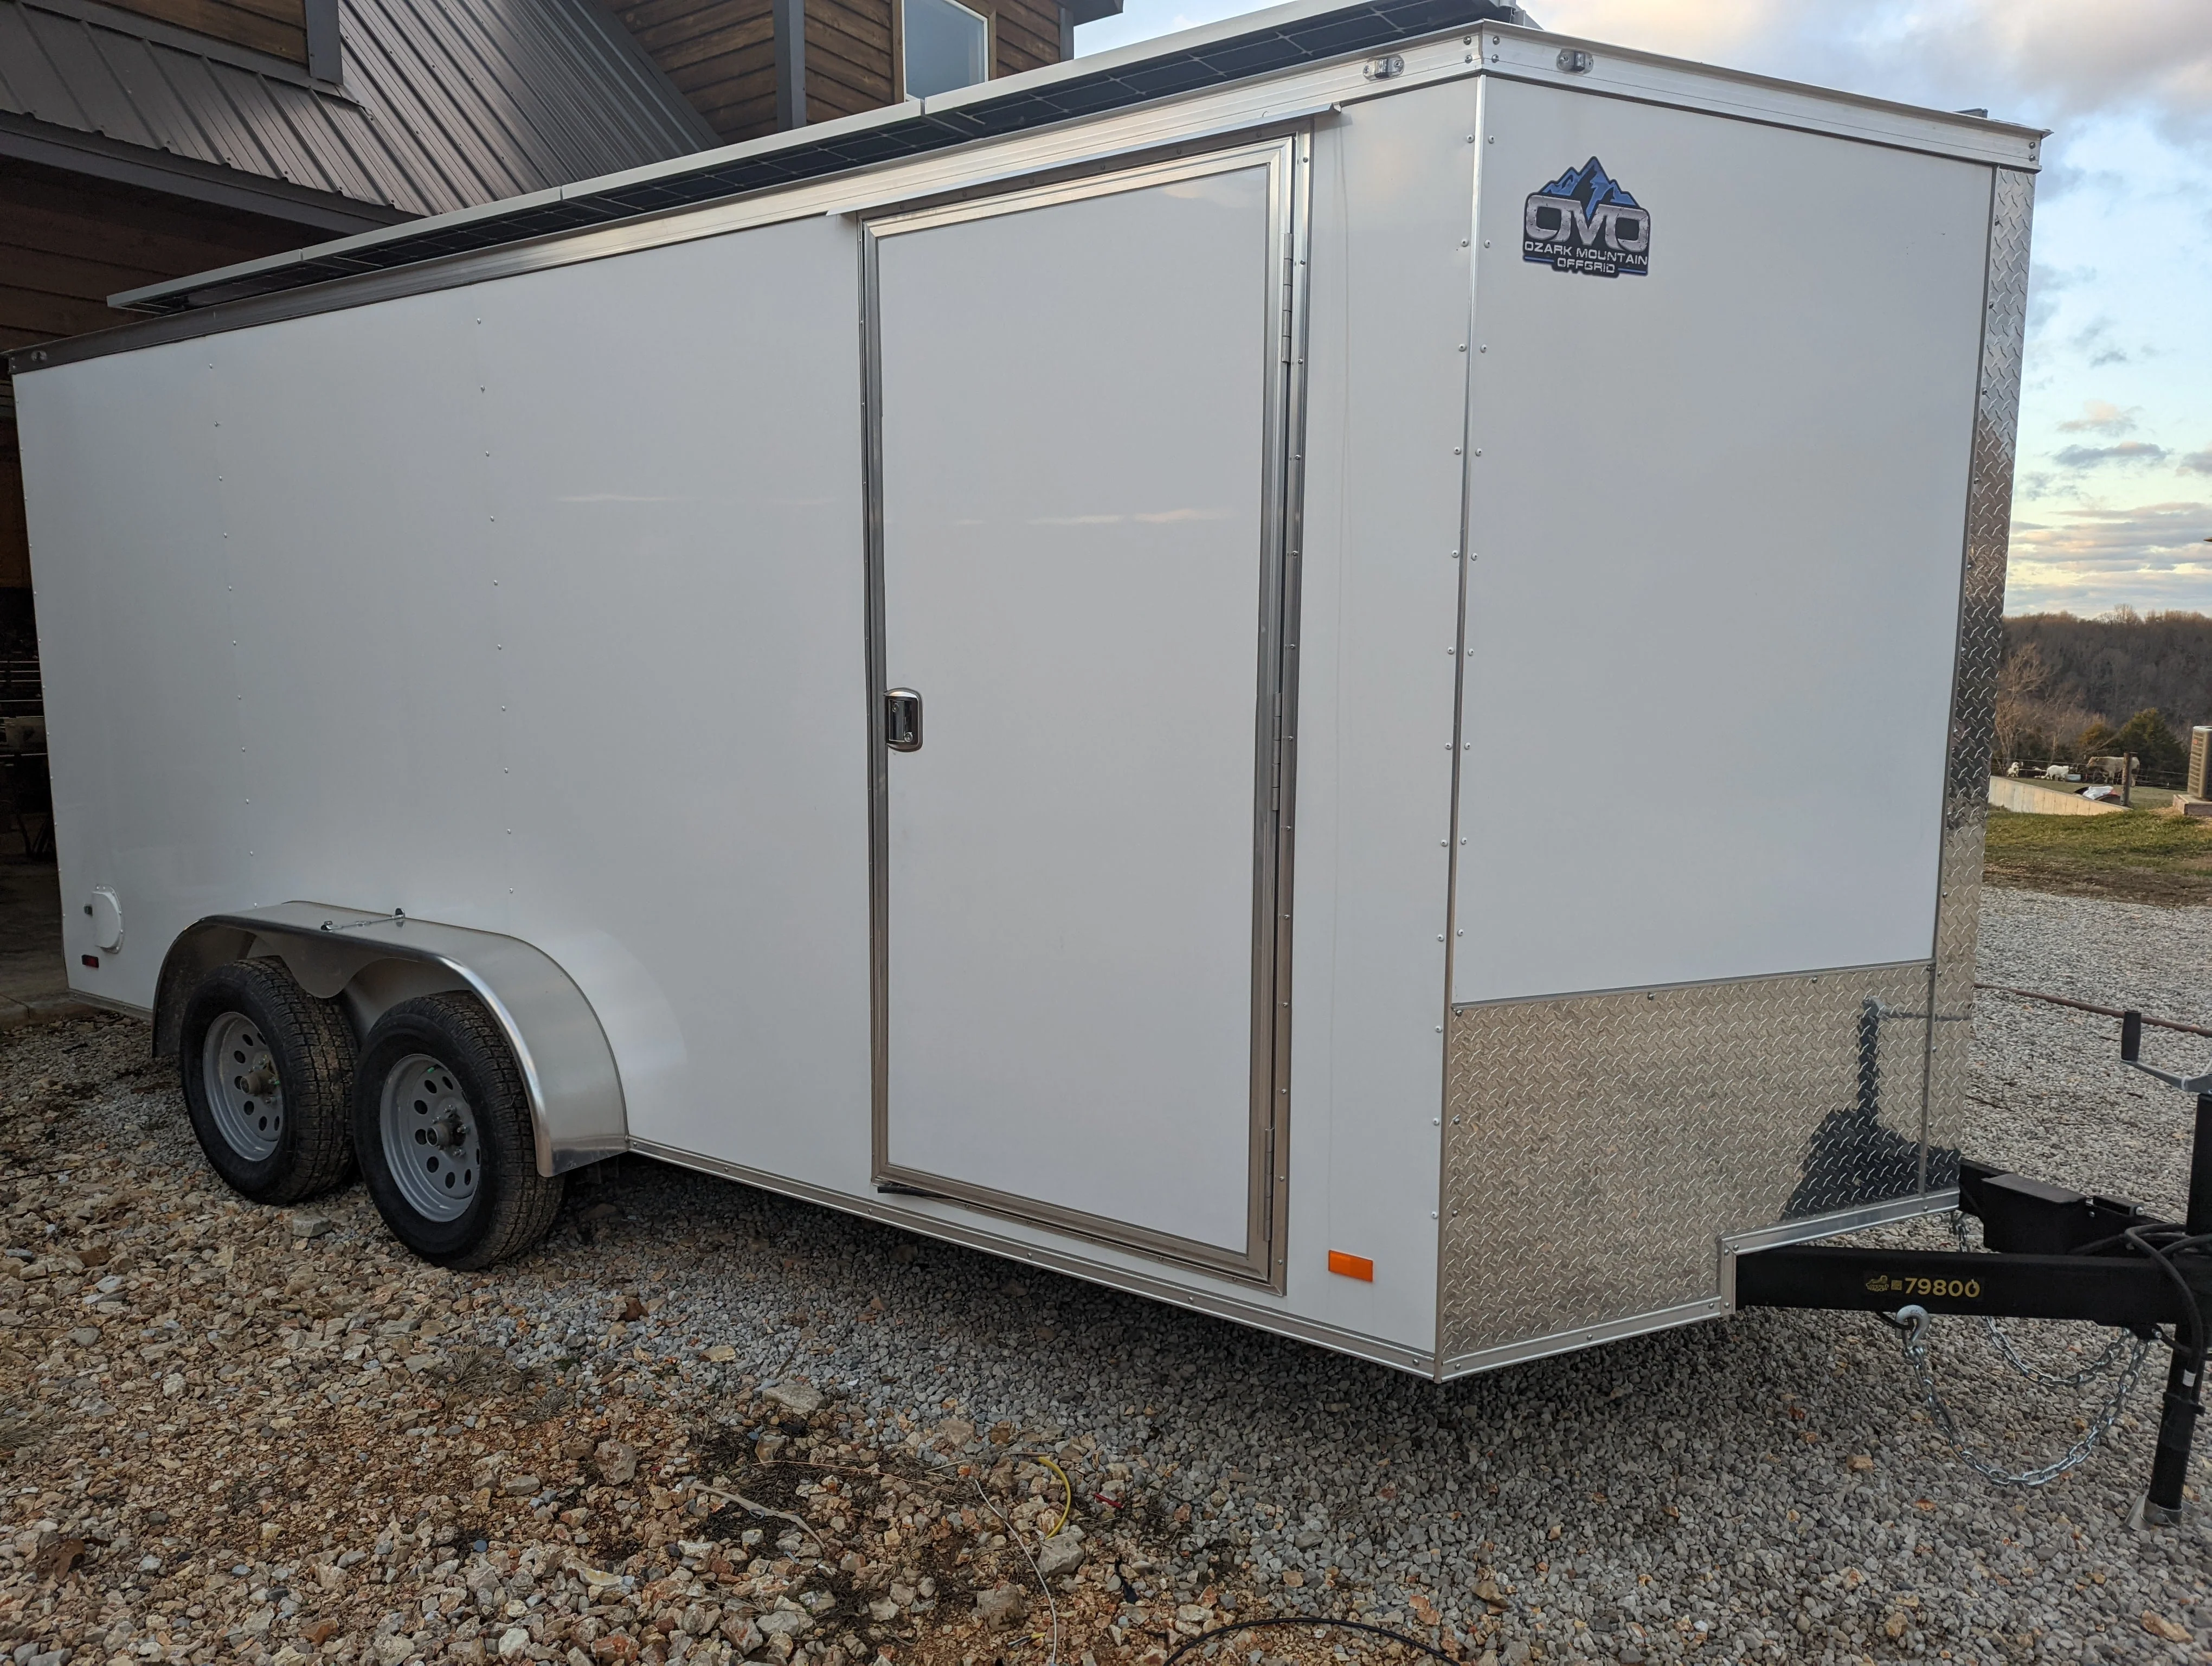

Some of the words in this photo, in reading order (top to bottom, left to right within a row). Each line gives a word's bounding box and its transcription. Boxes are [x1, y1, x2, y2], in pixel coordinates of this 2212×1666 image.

[1525, 241, 1572, 256] OZARK
[1576, 247, 1648, 265] MOUNTAIN
[1557, 258, 1615, 273] OFFGRID
[1905, 1277, 1980, 1298] 79800
